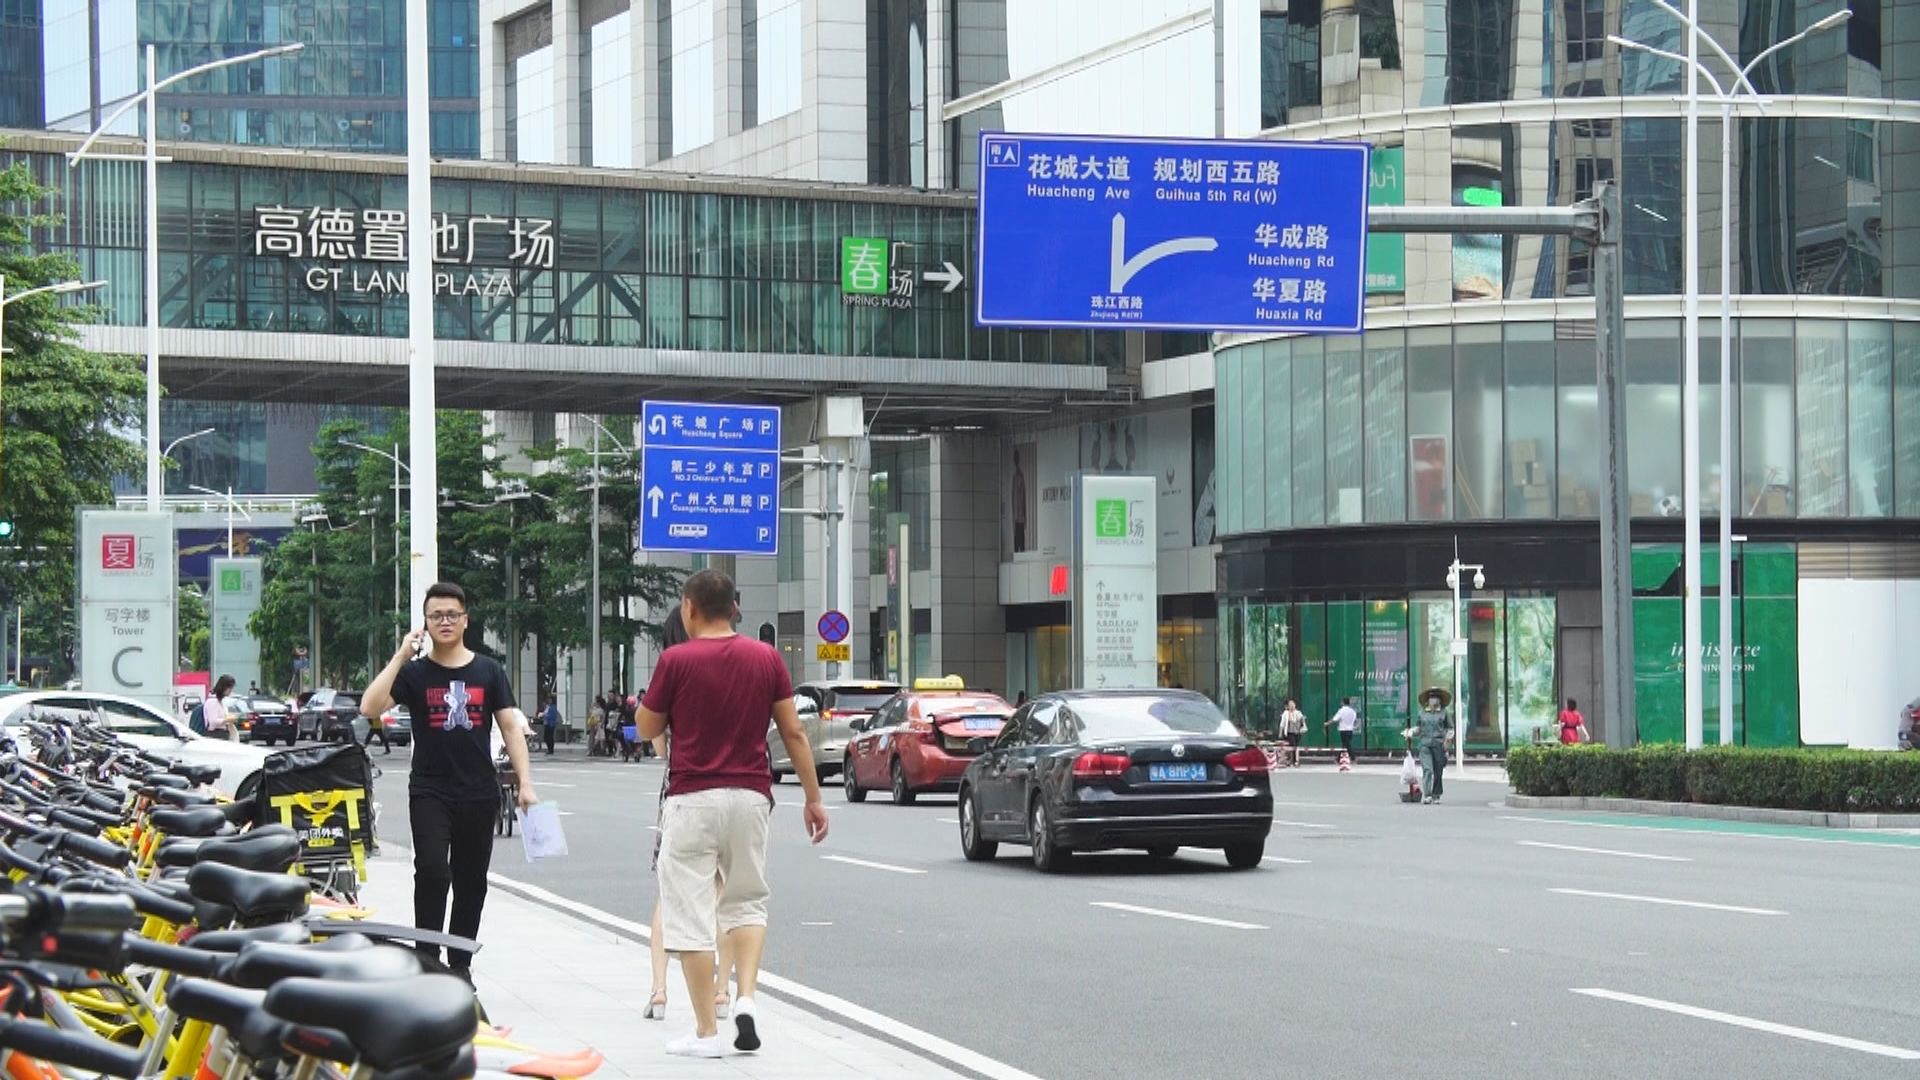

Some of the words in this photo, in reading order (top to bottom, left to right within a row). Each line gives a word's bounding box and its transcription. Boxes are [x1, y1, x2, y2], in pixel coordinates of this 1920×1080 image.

[1028, 153, 1131, 181] 花城大道
[1153, 157, 1280, 185] 规划西五路
[1027, 183, 1095, 201] Huacheng
[1105, 186, 1130, 199] Ave
[1155, 187, 1201, 201] Guihua
[1207, 189, 1227, 202] 5th
[1233, 190, 1250, 202] Rd
[1254, 187, 1277, 205] (W)
[1254, 222, 1329, 249] 华成路
[848, 242, 882, 290] 春
[1248, 253, 1311, 269] Huacheng
[1317, 255, 1335, 267] Rd
[306, 268, 343, 291] GT
[353, 271, 410, 294] LAN
[434, 273, 515, 297] PLAZA
[1252, 277, 1327, 304] 华夏路
[842, 295, 880, 306] SPRING
[881, 297, 912, 309] PLAZA
[1090, 295, 1143, 309] 珠江西路
[1256, 307, 1299, 320] Huaxia
[1305, 308, 1322, 321] Rd
[671, 414, 754, 431] 花城广场
[671, 459, 754, 476] 第二少年宫
[670, 492, 752, 507] 广州大剧院
[1101, 501, 1121, 536] 春
[106, 537, 132, 568] 夏
[104, 607, 150, 623] 写字楼
[112, 626, 145, 636] Tower
[112, 646, 143, 688] C
